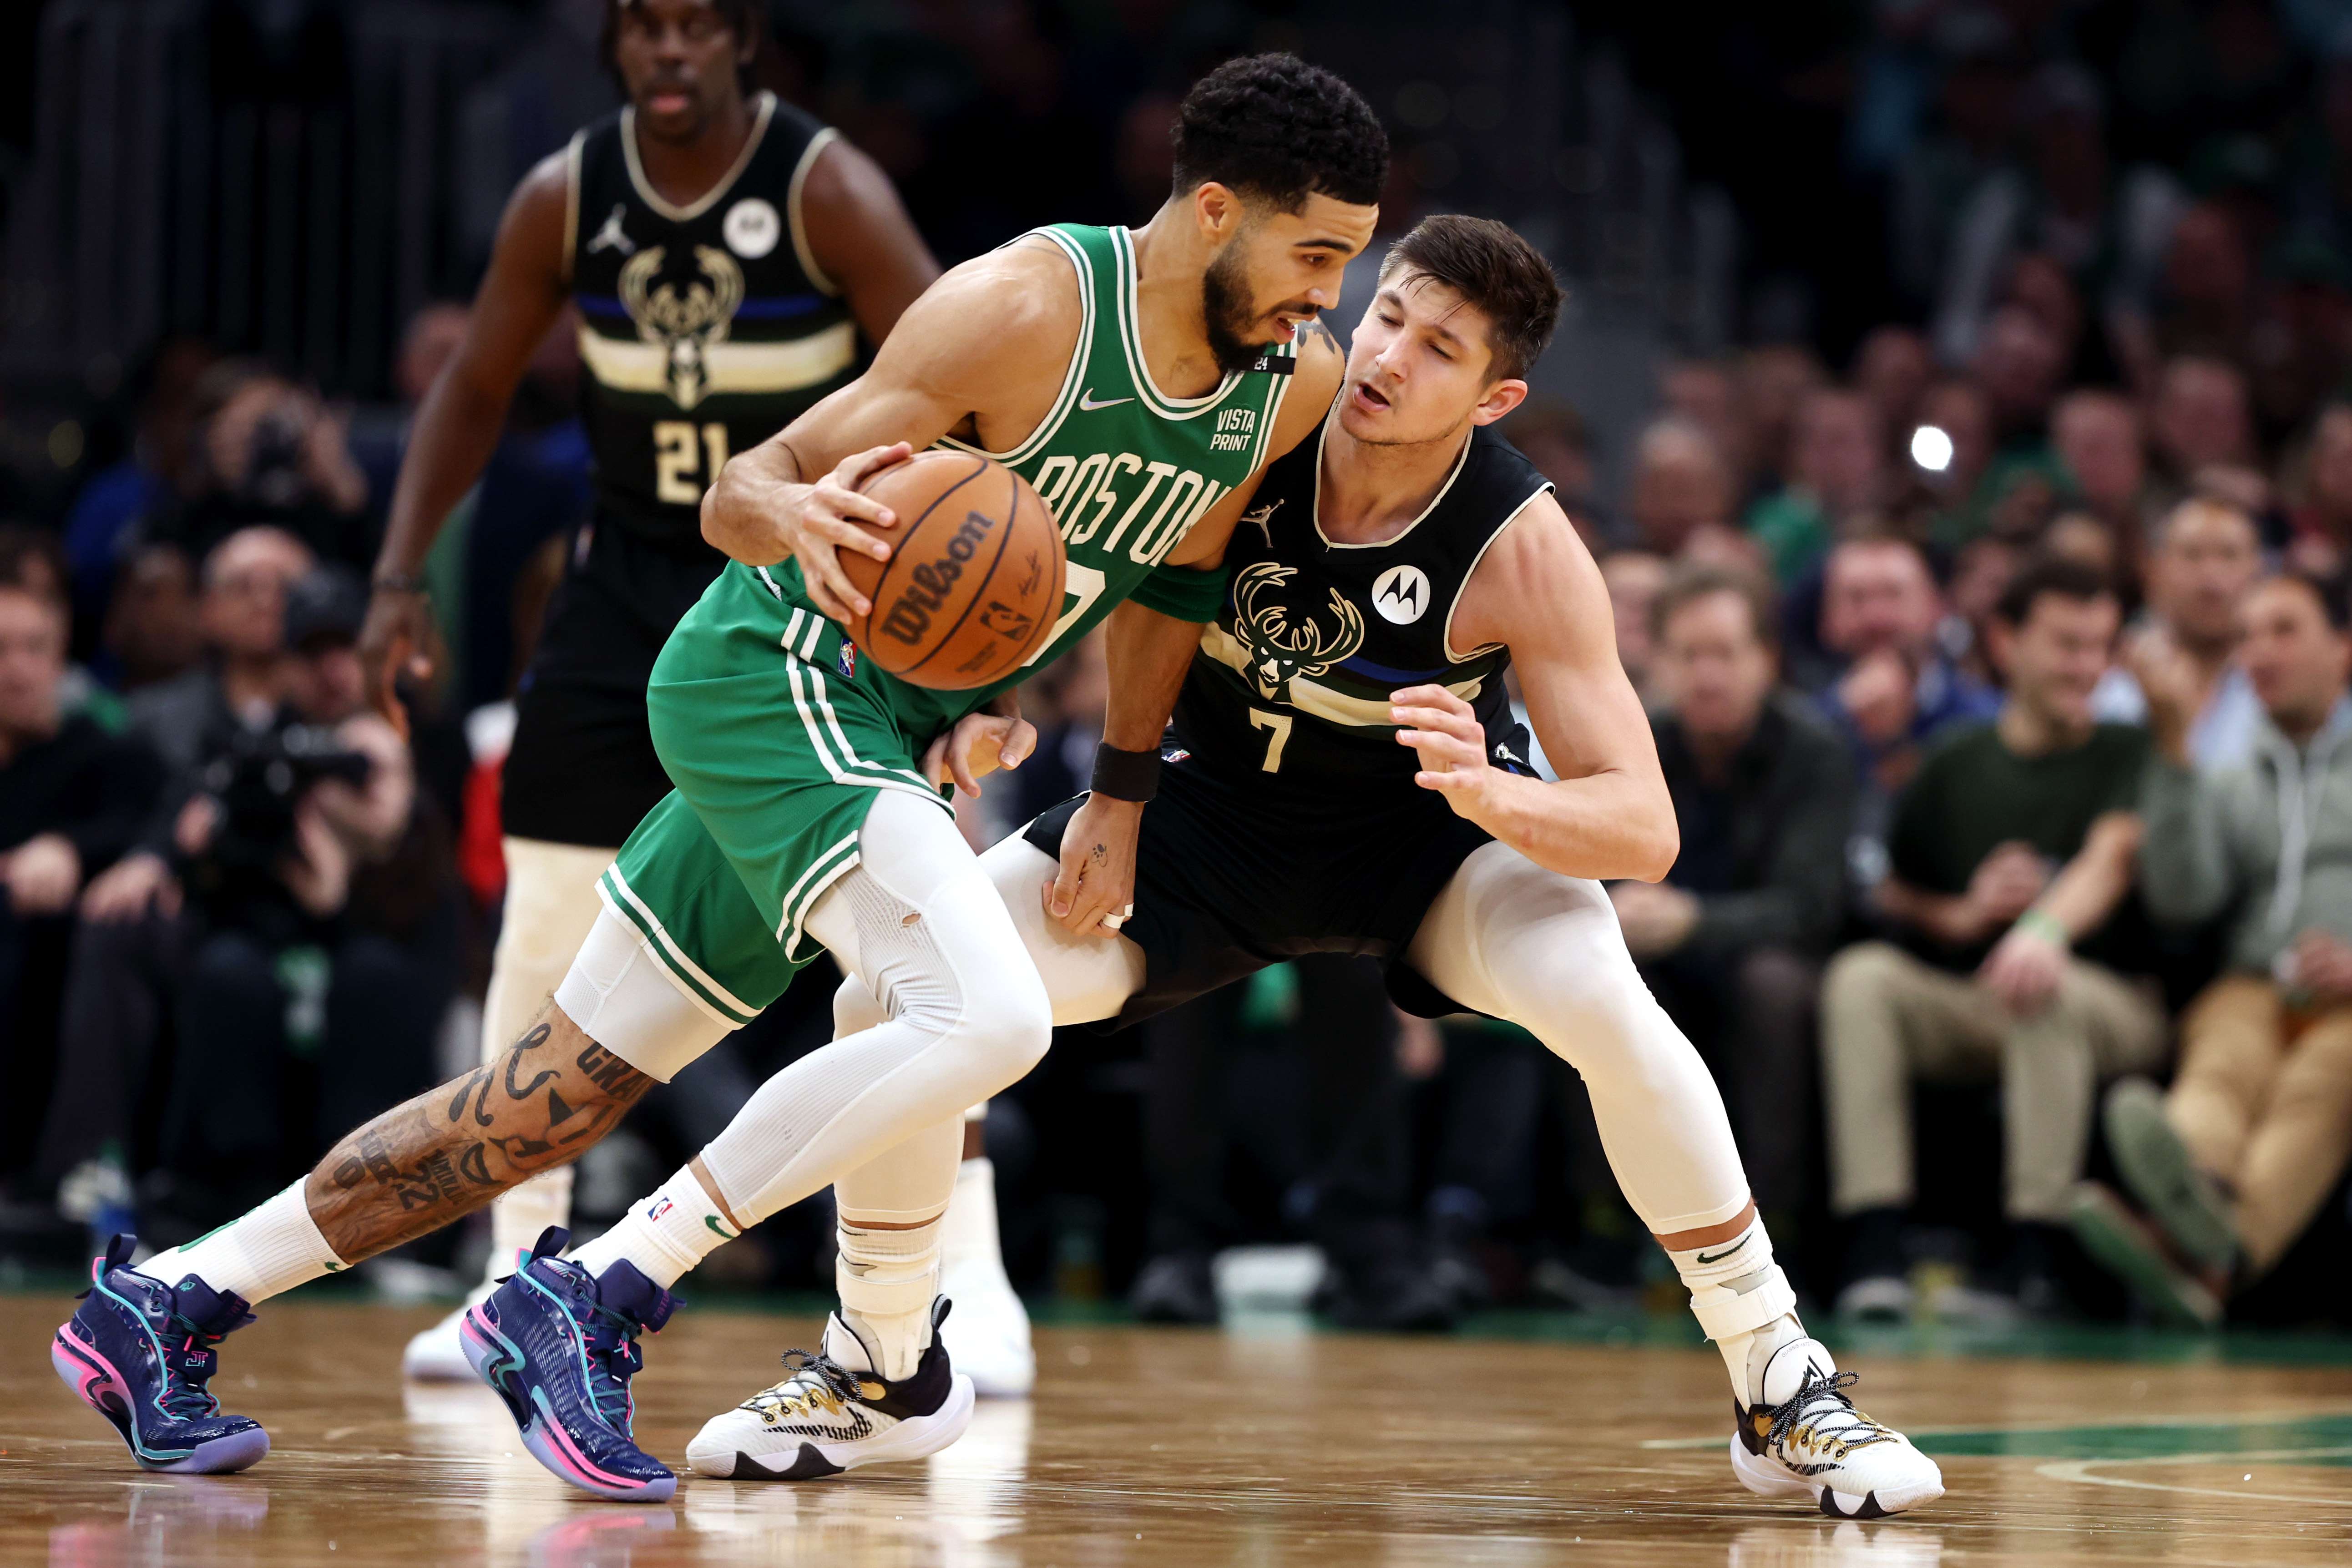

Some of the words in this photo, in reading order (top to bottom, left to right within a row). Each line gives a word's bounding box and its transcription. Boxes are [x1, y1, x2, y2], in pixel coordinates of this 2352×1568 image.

[1254, 356, 1268, 370] 24
[1216, 409, 1256, 434] VISTA
[1209, 434, 1251, 451] PRINT
[653, 420, 728, 505] 21
[879, 510, 996, 646] Wilson
[1249, 707, 1293, 773] 7
[391, 1161, 440, 1210] 22
[1781, 1344, 1799, 1358] GIANNIS
